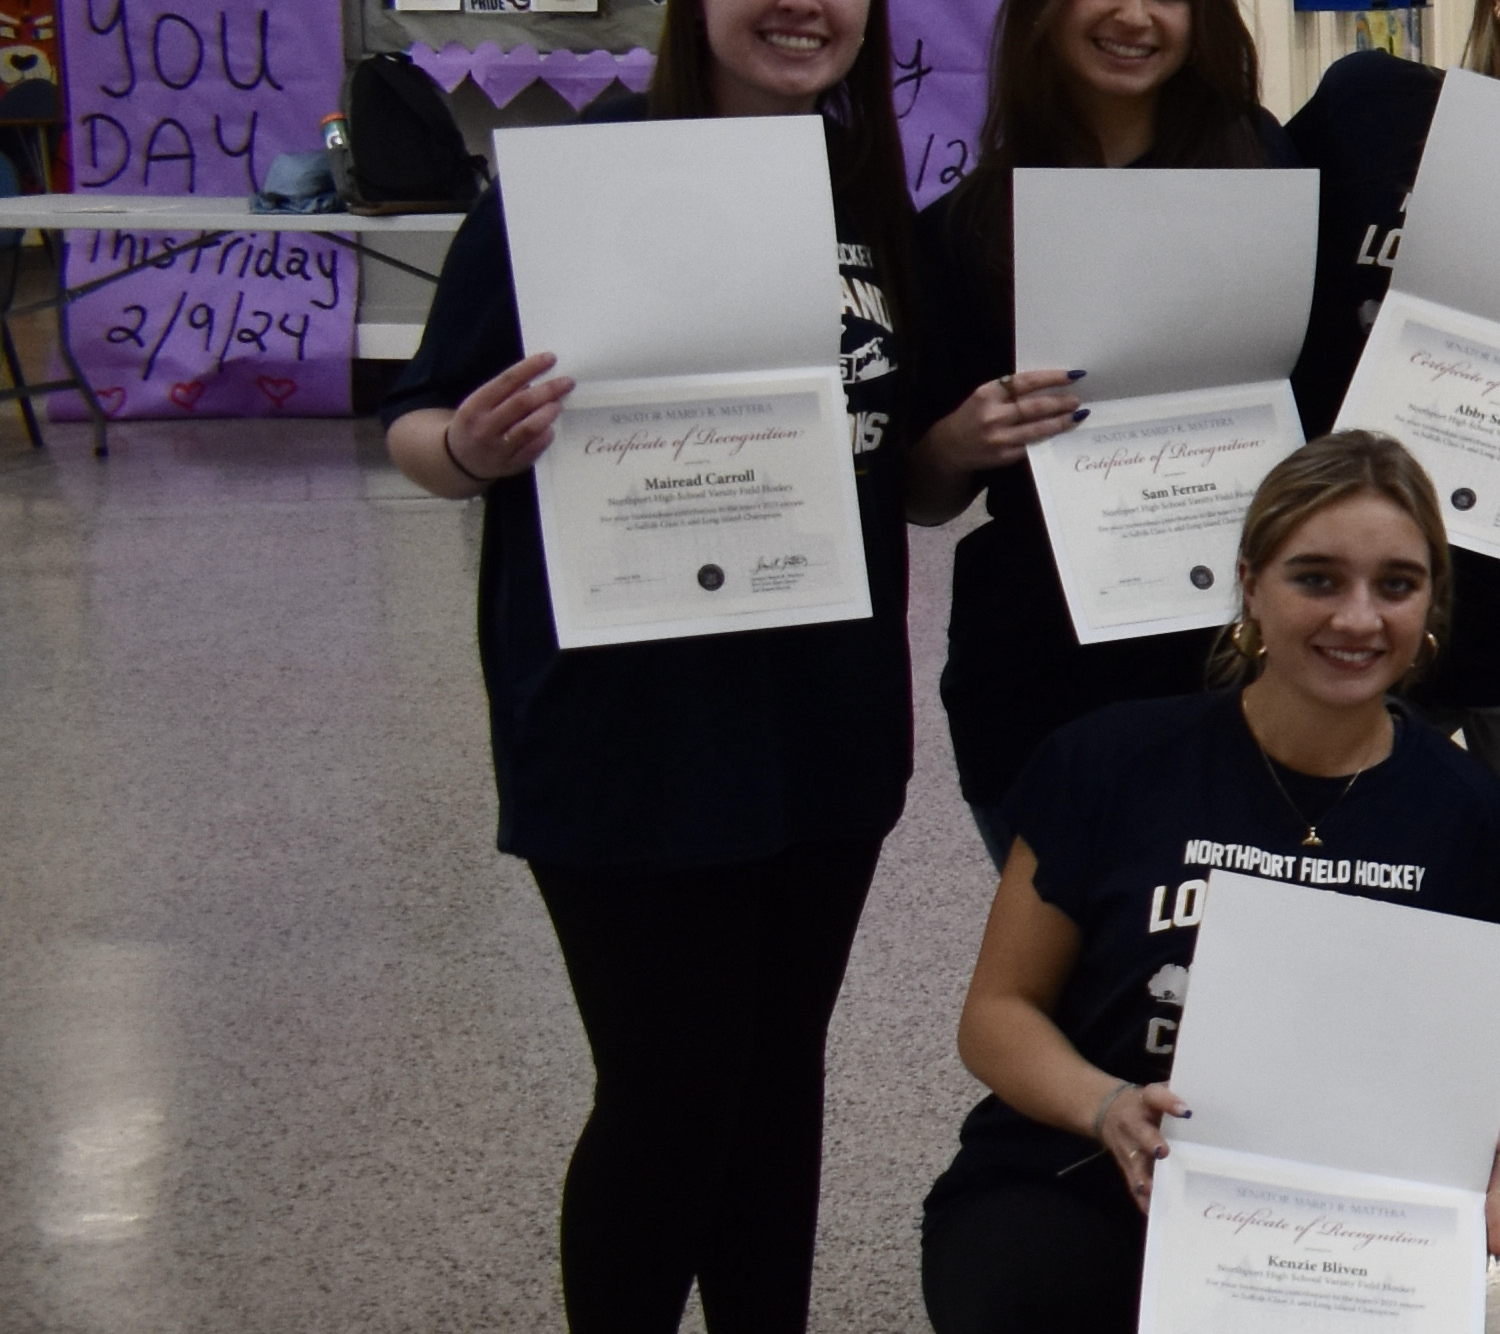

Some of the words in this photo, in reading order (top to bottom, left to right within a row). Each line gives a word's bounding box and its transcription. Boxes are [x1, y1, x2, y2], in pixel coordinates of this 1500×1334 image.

[80, 110, 259, 194] DAY
[1357, 223, 1403, 269] LO
[106, 291, 310, 381] 2/9/24
[1457, 404, 1488, 425] Abby
[645, 474, 702, 490] Mairead
[706, 469, 755, 486] Carroll
[1142, 488, 1167, 500] Sam
[1171, 482, 1217, 497] Ferrara
[1185, 839, 1296, 879] NORTHPORT
[1301, 856, 1351, 885] FIELD
[1354, 859, 1426, 892] HOCKEY
[1148, 880, 1207, 933] LO
[1268, 1255, 1319, 1273] Kenzie
[1322, 1260, 1368, 1278] Bliven
